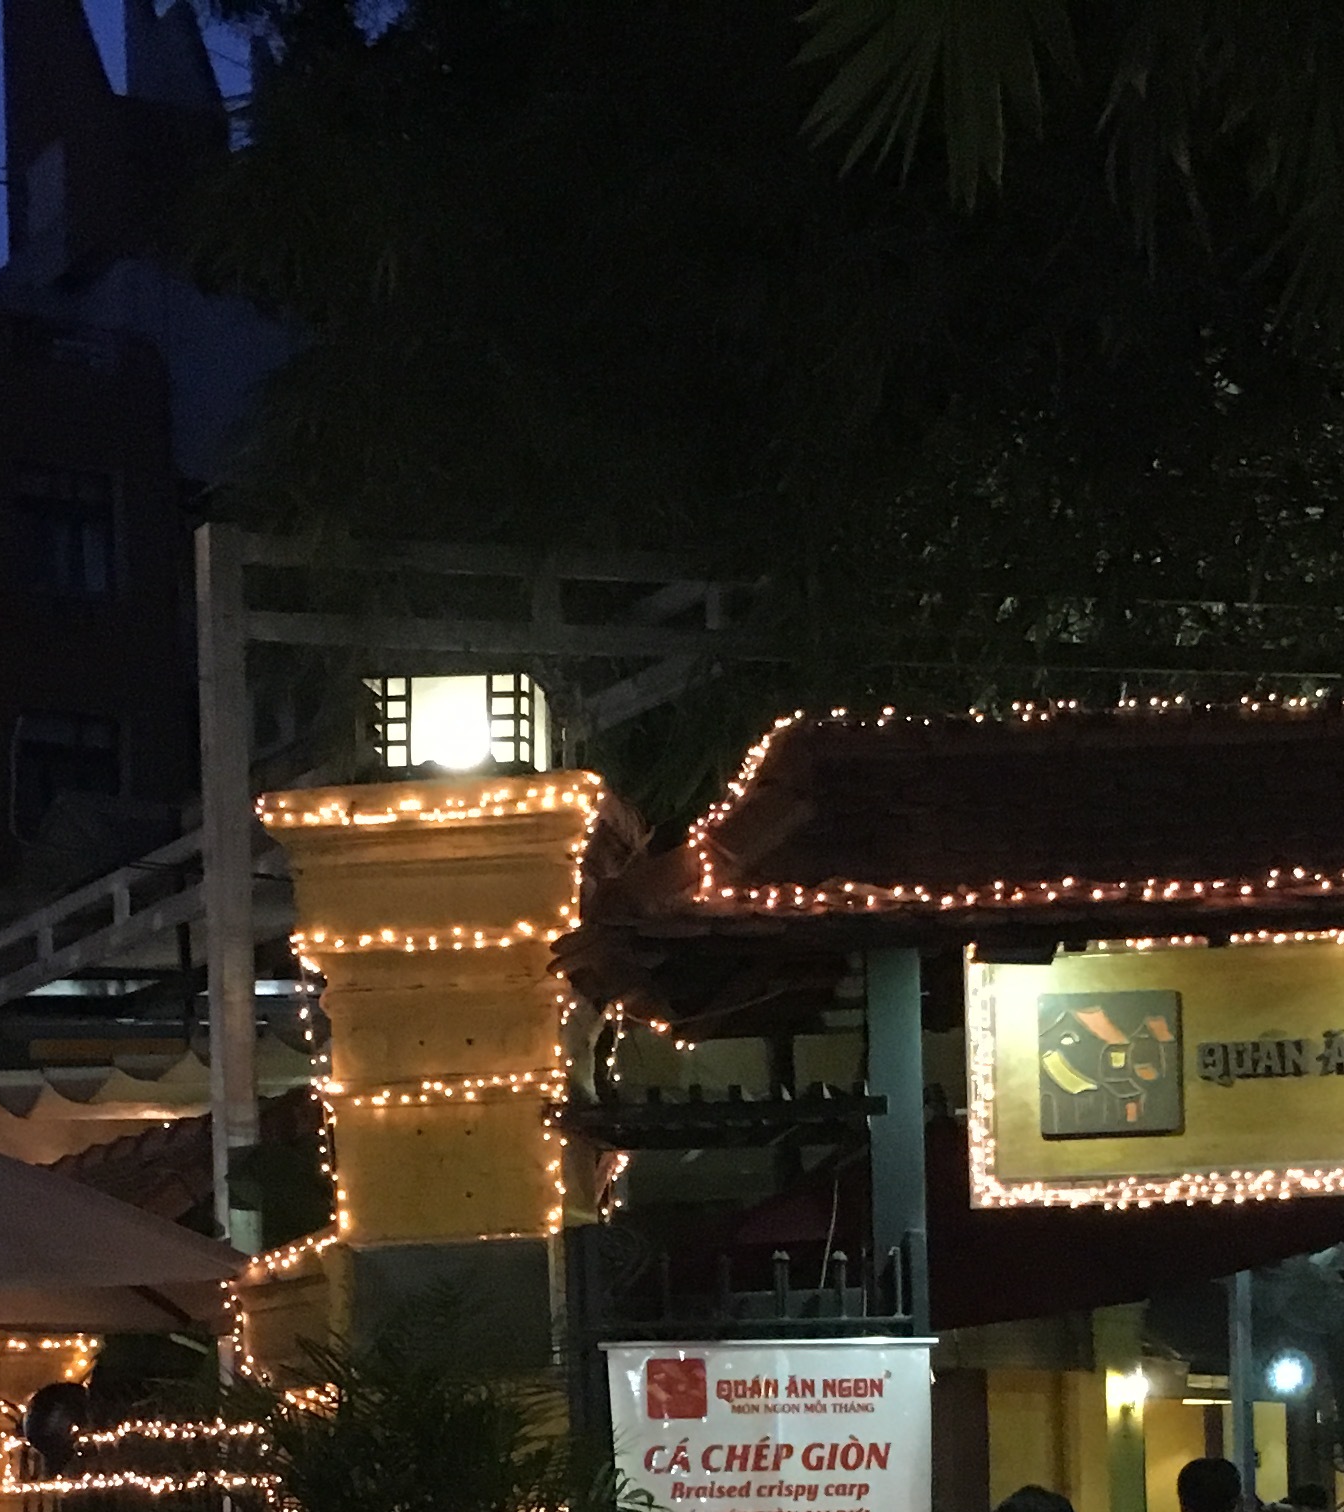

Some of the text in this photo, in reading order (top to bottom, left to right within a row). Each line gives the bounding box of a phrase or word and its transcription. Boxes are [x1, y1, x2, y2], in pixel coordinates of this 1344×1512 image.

[716, 1375, 884, 1402] QUÁN ĂN NGON
[764, 1403, 800, 1414] NGON
[831, 1401, 875, 1413] THÁNG
[644, 1434, 892, 1474] CÁ CHÉP GIÒN
[670, 1480, 870, 1501] Braised crispy carp
